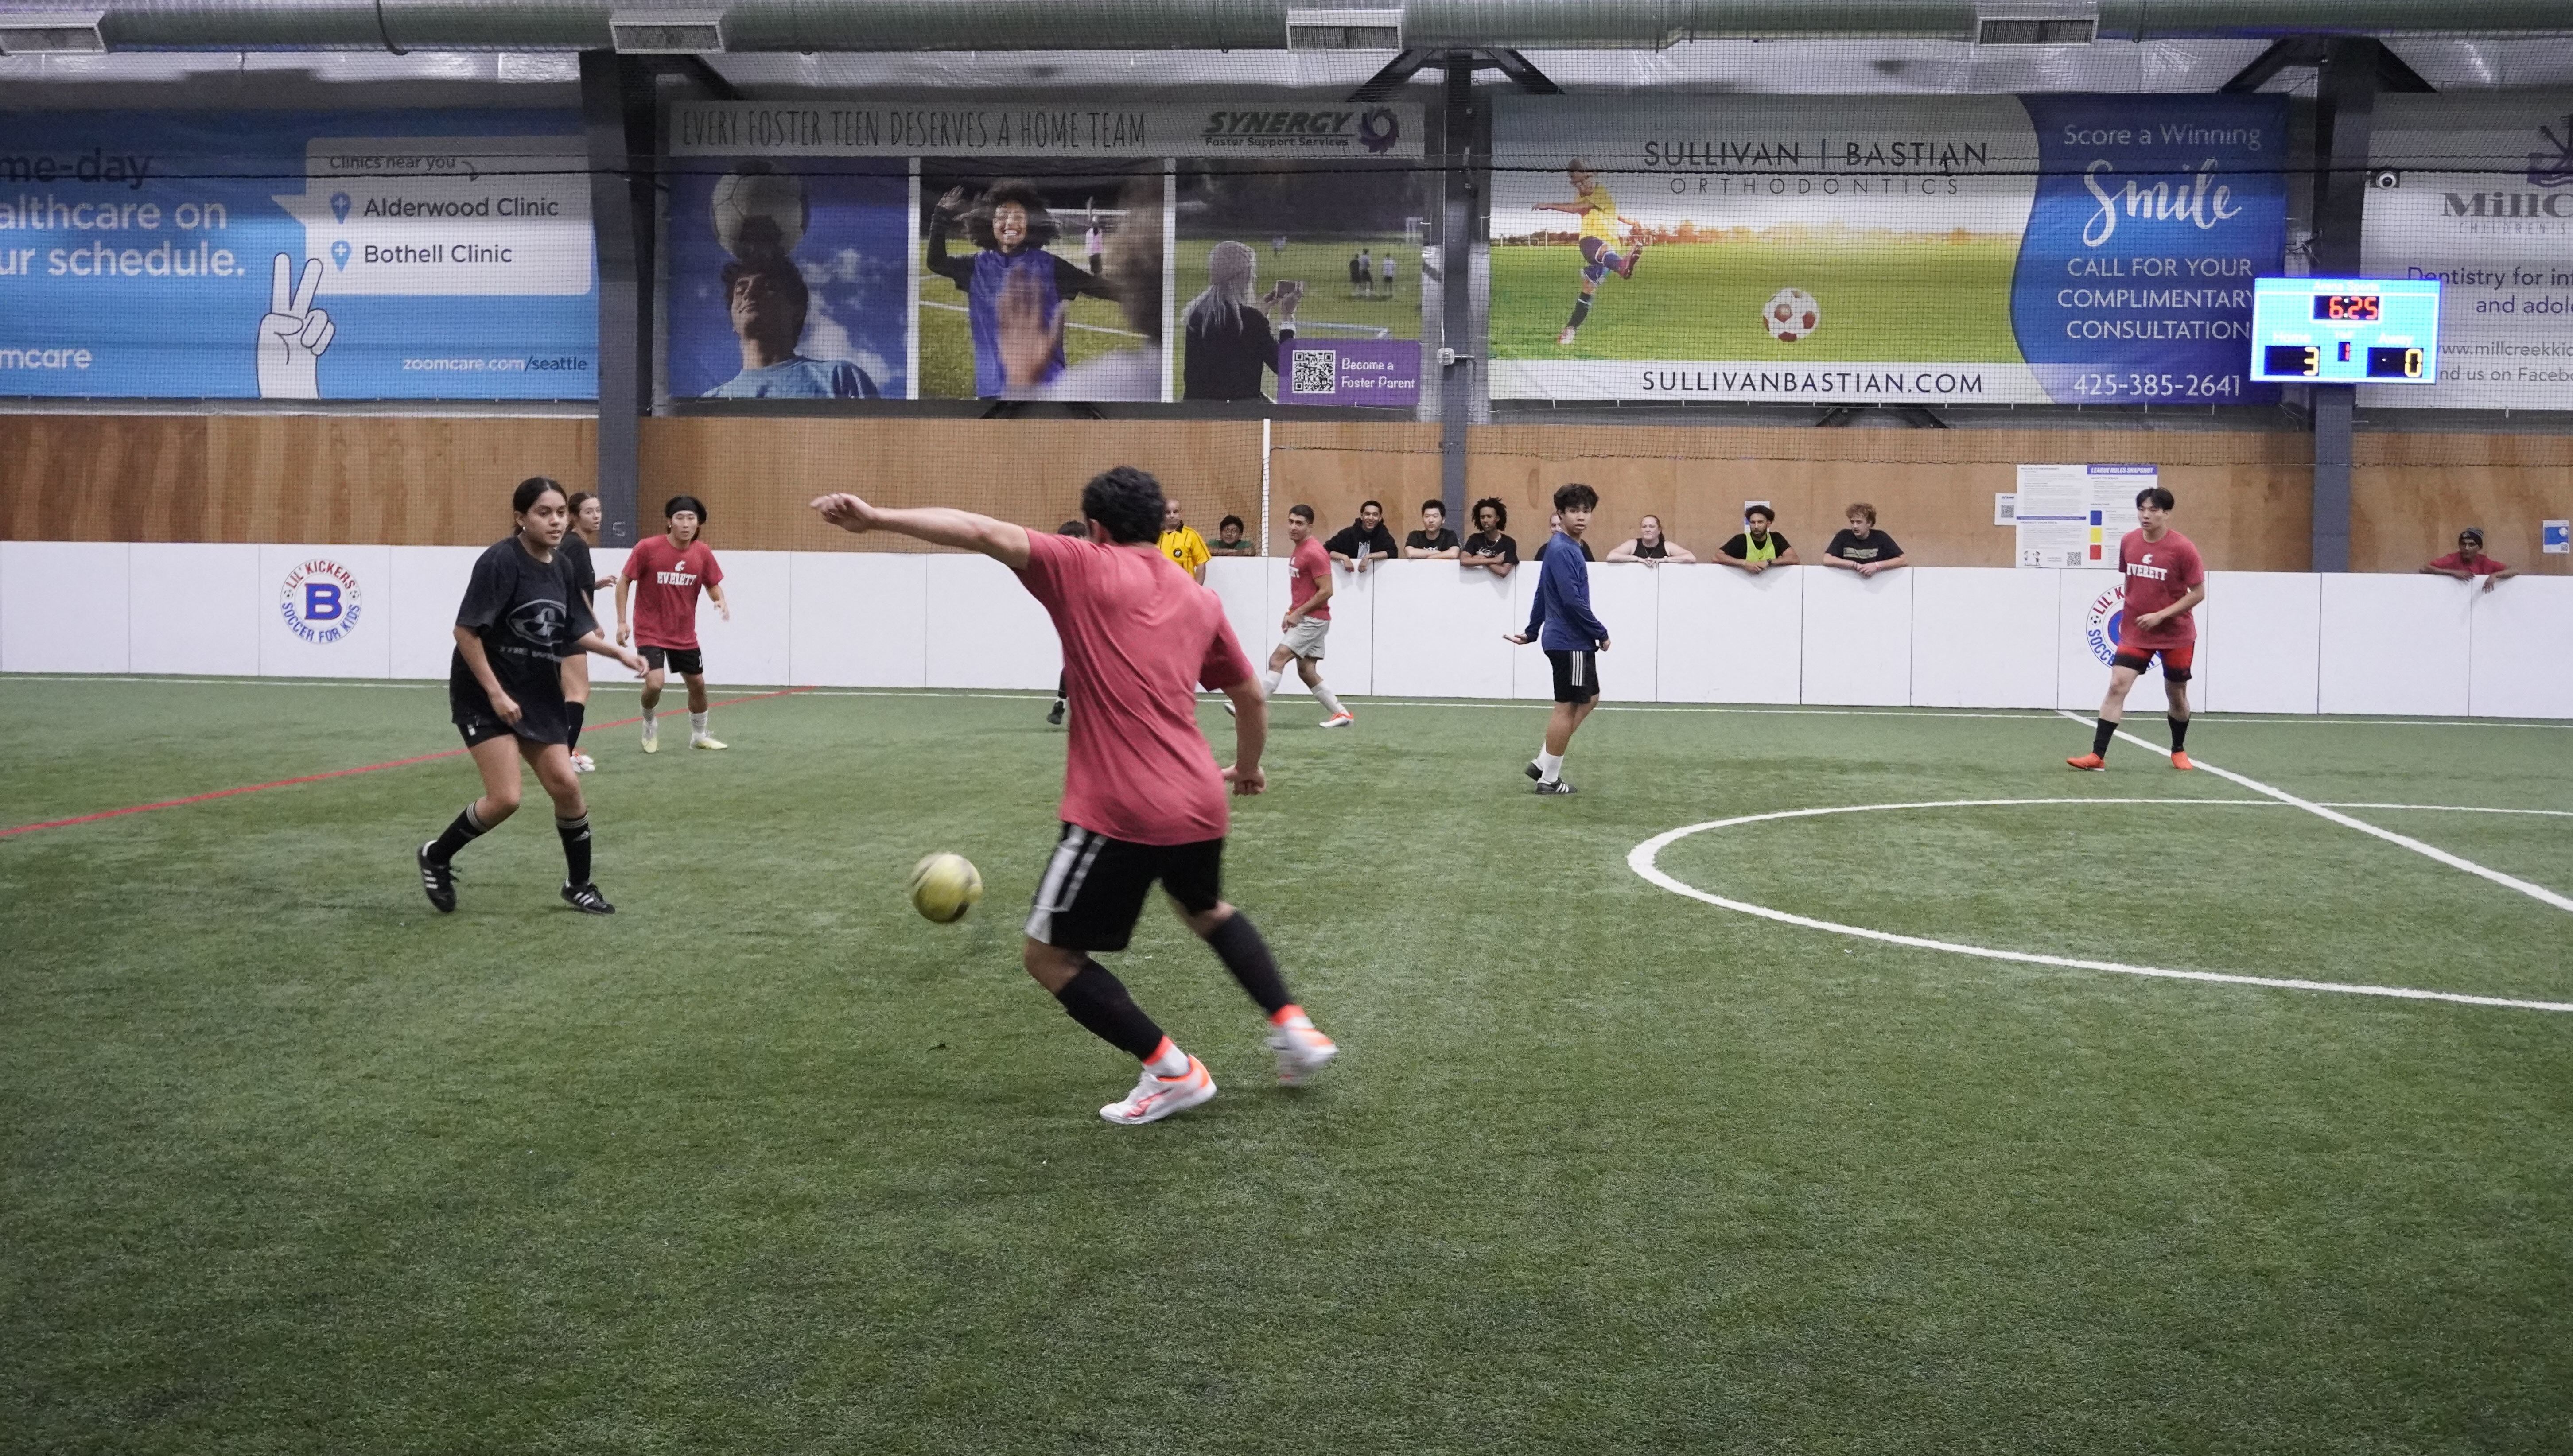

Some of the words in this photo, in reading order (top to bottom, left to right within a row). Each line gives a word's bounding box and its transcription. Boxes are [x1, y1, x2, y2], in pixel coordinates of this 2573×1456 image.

[684, 111, 737, 146] EVERY
[749, 111, 822, 146] FOSTER
[830, 111, 879, 146] TEEN
[890, 112, 987, 147] DESERVES
[997, 112, 1009, 147] A
[1021, 112, 1079, 148] HOME
[1088, 112, 1145, 148] TEAM
[1204, 112, 1353, 133] SYNERGY
[1206, 137, 1242, 147] Foster
[1247, 137, 1294, 148] Support
[1299, 137, 1349, 147] Services
[2064, 124, 2131, 145] Score
[2139, 129, 2151, 145] a
[2160, 124, 2261, 151] Winning
[1644, 141, 1799, 167] SULLIVAN
[1847, 142, 1987, 167] BASTIAN
[330, 157, 381, 169] Clinics
[386, 158, 421, 168] near
[427, 158, 455, 173] you
[1671, 179, 1957, 194] ORTHODONTICS
[0, 194, 161, 229] althcare
[176, 202, 227, 229] on
[364, 197, 489, 216] Alderwood
[497, 197, 559, 216] Clinic
[2083, 157, 2242, 247] Smile
[48, 240, 245, 276] schedule.
[365, 245, 443, 263] Bothell
[451, 245, 513, 263] Clinic
[2068, 258, 2125, 277] CALL
[2132, 258, 2178, 277] FOR
[2185, 258, 2253, 277] YOUR
[2513, 266, 2543, 285] for
[2329, 296, 2378, 319] 6:25
[2476, 295, 2515, 313] and
[2523, 295, 2573, 314] adol
[2067, 320, 2250, 339] CONSULTATION
[2303, 346, 2319, 376] 3
[2345, 343, 2350, 360] 1
[403, 356, 587, 373] zoomcare.com/seattle
[1341, 357, 1384, 370] Become
[1387, 362, 1394, 371] a
[2404, 348, 2423, 378] 0
[2467, 370, 2484, 380] us
[2490, 370, 2511, 381] on
[2519, 366, 2573, 381] Faceb
[1341, 376, 1375, 388] Foster
[1378, 376, 1415, 389] Parent
[1642, 371, 1982, 393] SULLIVANBASTIAN.COM
[2074, 374, 2240, 396] 425-385-2641
[286, 567, 303, 589] LIL'
[305, 560, 355, 589] KICKERS
[2126, 563, 2168, 581] EVERETT
[304, 583, 342, 619] B
[2093, 592, 2113, 615] LIL'
[282, 602, 315, 642] SOCCER
[319, 628, 341, 643] FOR
[340, 604, 360, 632] KIDS
[2088, 629, 2116, 665] SOCC
